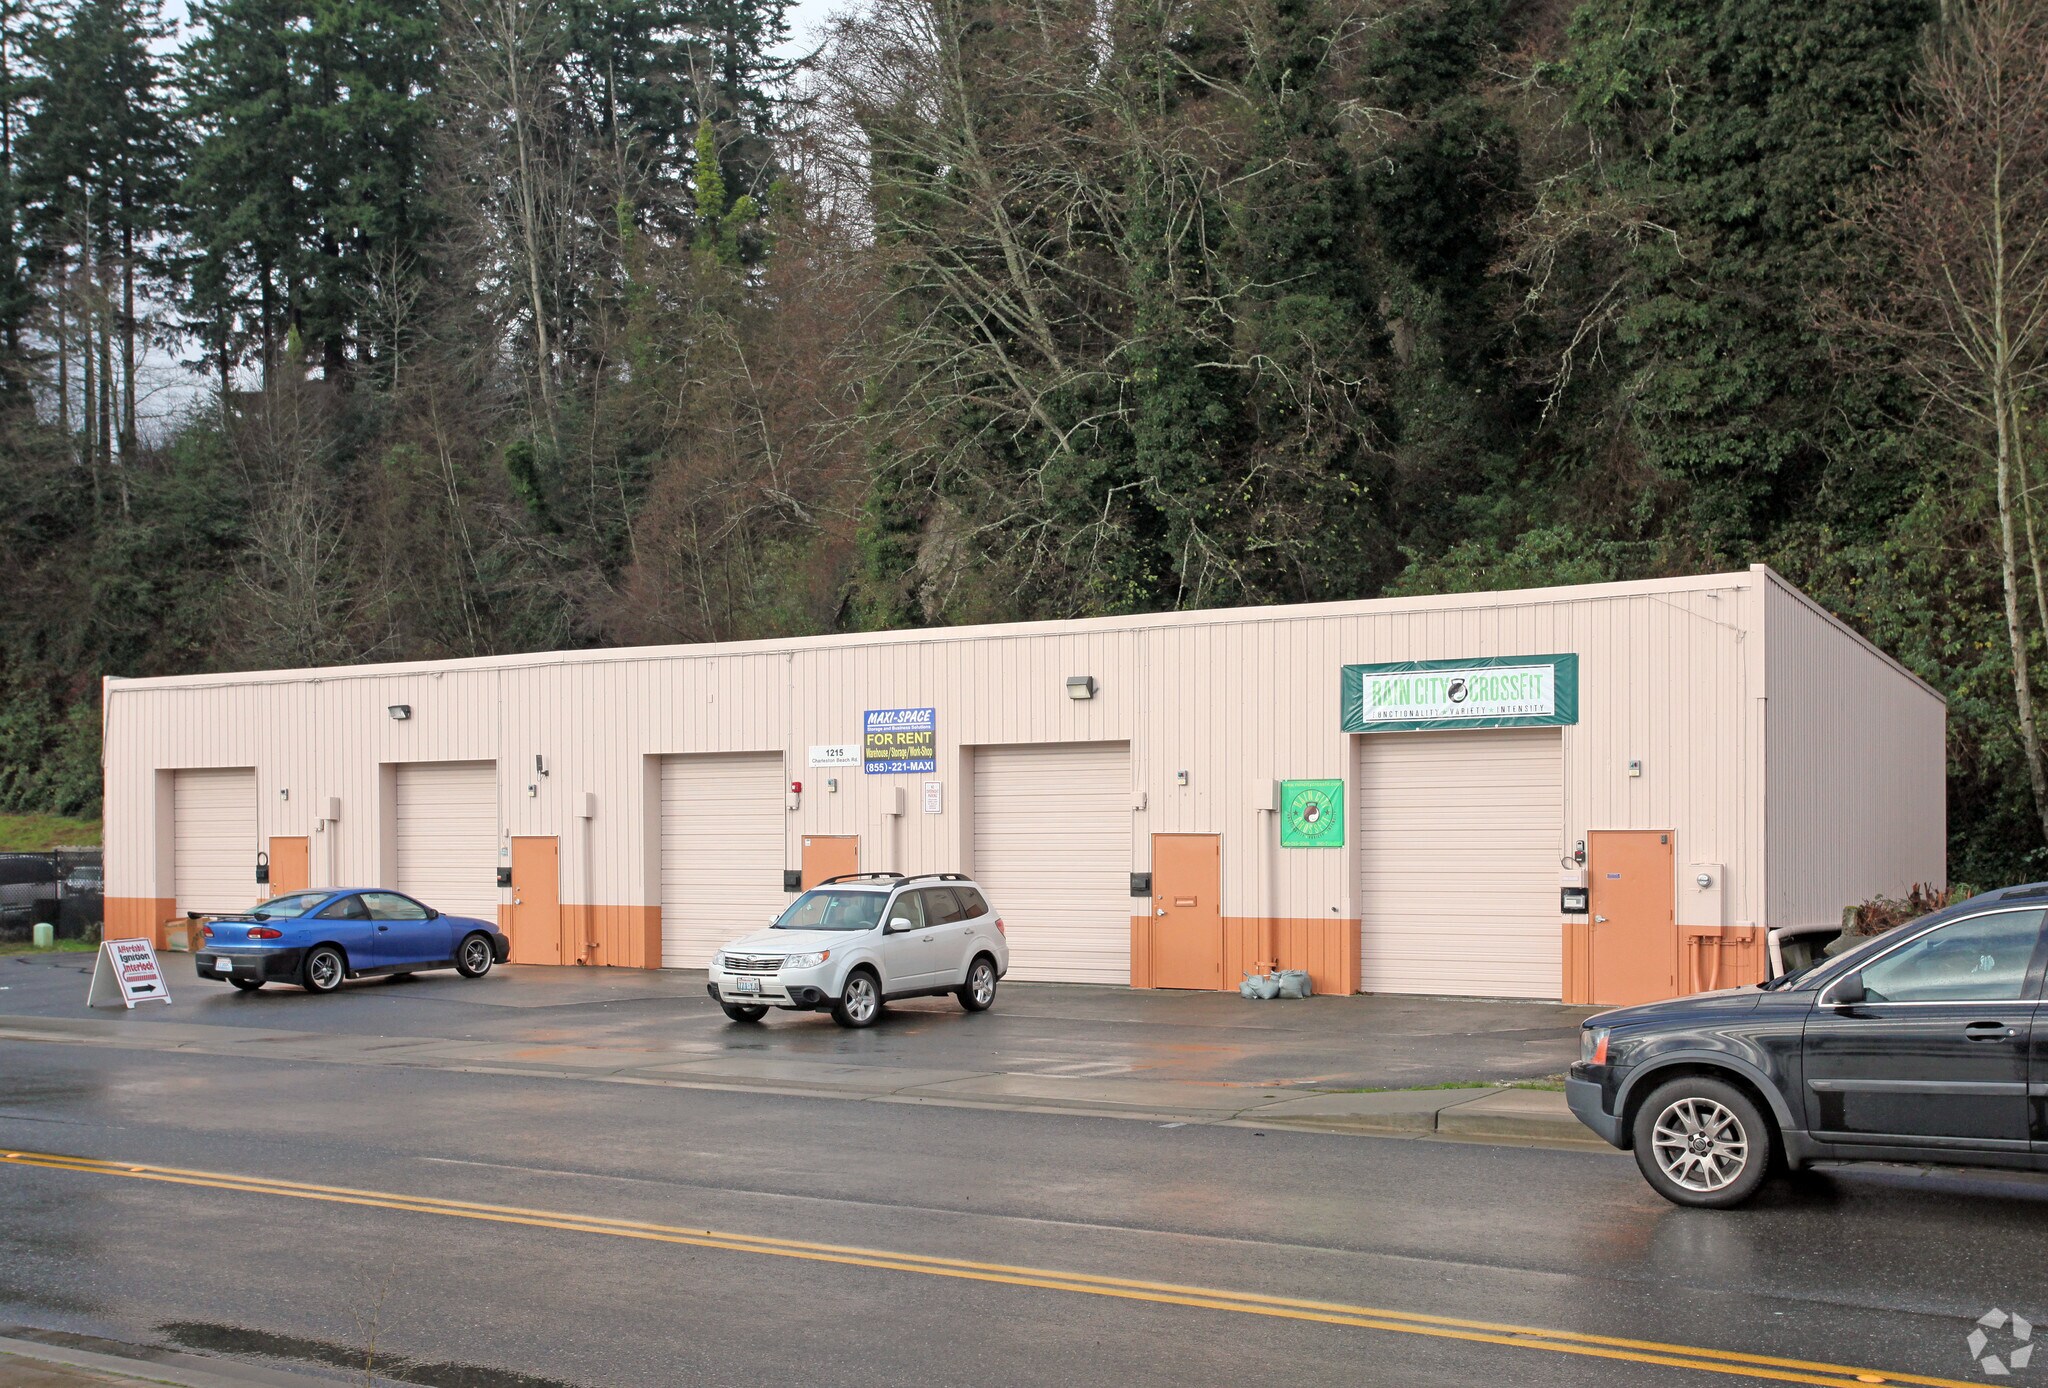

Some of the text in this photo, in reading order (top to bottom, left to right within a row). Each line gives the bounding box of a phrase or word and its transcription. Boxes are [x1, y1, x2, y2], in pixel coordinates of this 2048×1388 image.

[1373, 673, 1543, 706] RAIN CITY CROSSFIT
[867, 710, 931, 724] MAXI-SPACE
[1373, 704, 1544, 718] FUNCTIONALITY VARIETY INTENSITY
[867, 732, 931, 745] FOR RENT
[826, 749, 844, 757] 1215
[118, 944, 145, 953] Affordable
[120, 953, 150, 963] Ignition
[123, 961, 154, 972] Interlock
